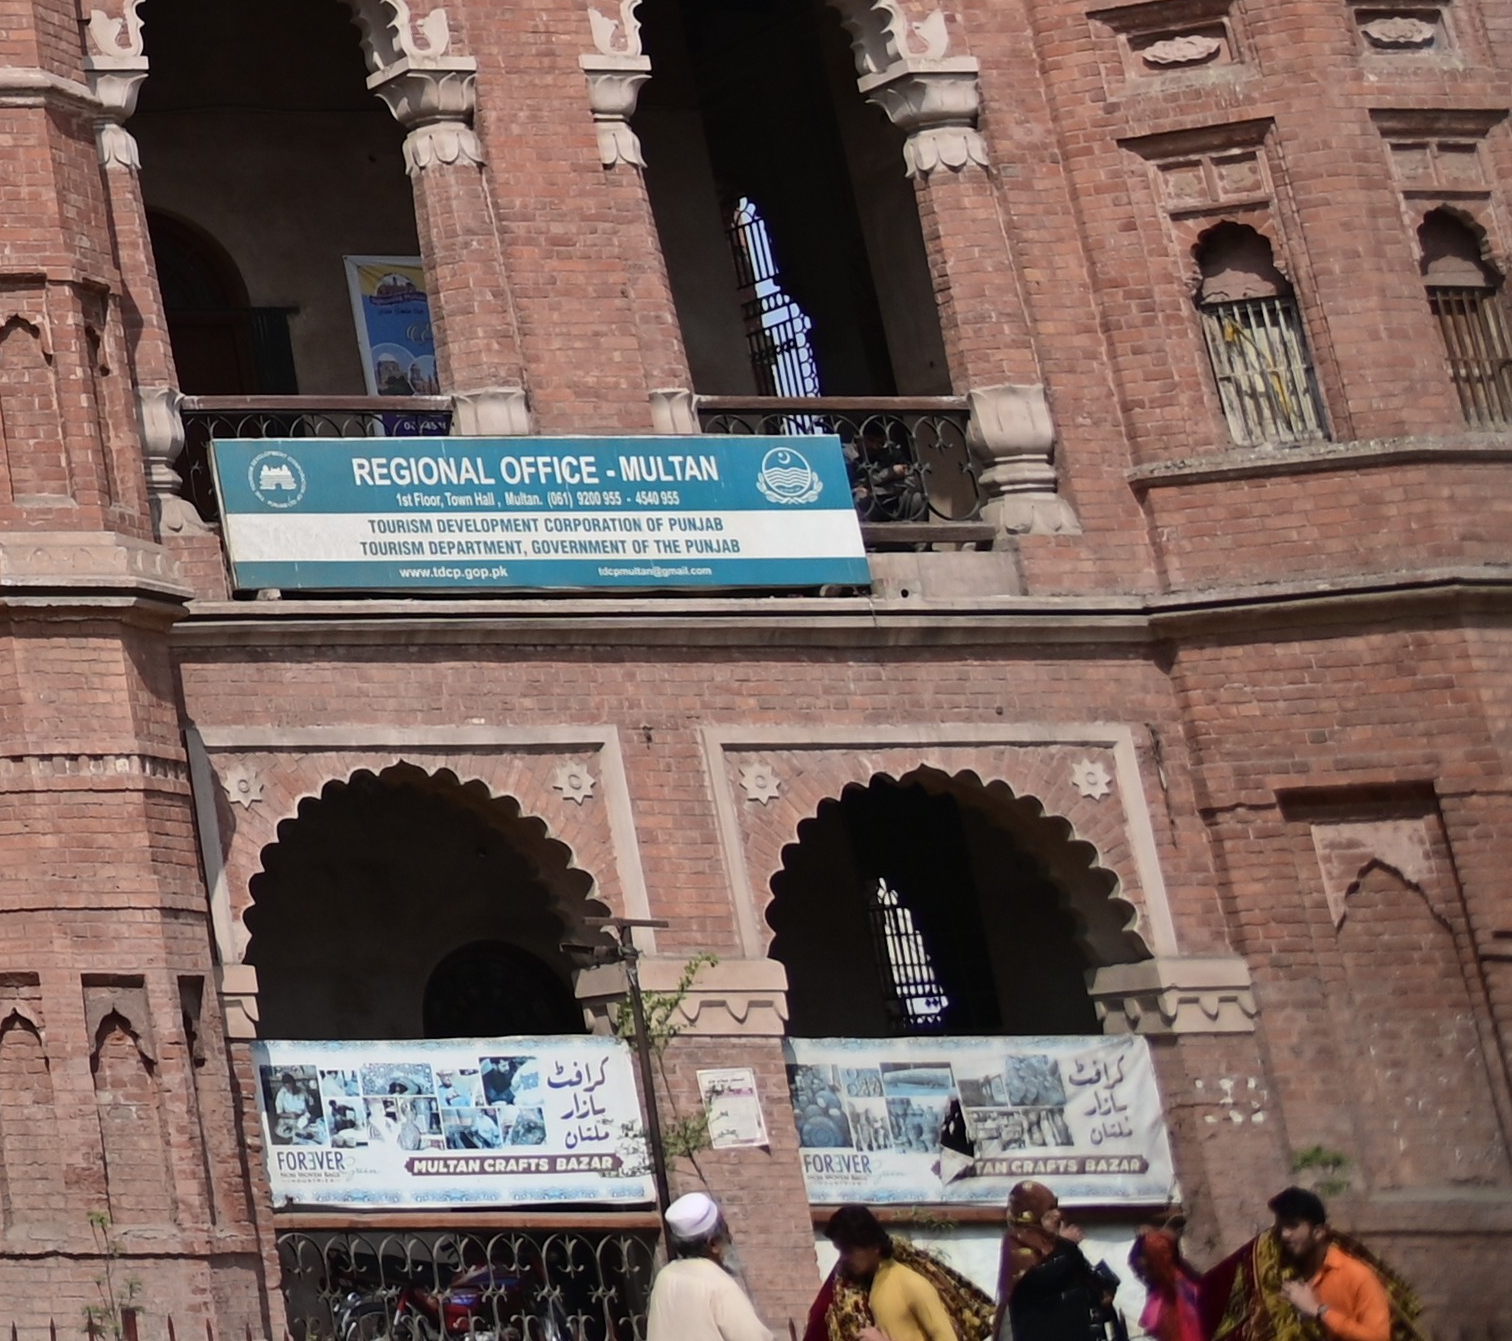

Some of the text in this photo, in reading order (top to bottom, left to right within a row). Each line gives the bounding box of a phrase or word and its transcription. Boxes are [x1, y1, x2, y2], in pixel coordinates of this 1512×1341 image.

[351, 457, 495, 485] REGIONAL
[499, 456, 599, 485] OFFICE
[620, 455, 719, 481] MULTAN
[396, 492, 413, 506] 1st
[413, 492, 444, 508] Floor,
[444, 492, 473, 506] Town
[474, 491, 495, 506] Hall
[547, 491, 573, 509] (061)
[577, 491, 601, 505] 9200
[602, 491, 622, 505] 955
[635, 491, 659, 505] 4540
[660, 491, 680, 505] 955
[368, 517, 723, 534] TOURISM DEVELOPMENT CORPORATION OF PUNJAB
[360, 539, 741, 557] TOURISM DEPARTMENT, GOVERNMENT OF THE PUNJAB
[399, 566, 712, 580] www.tdcp.gop.pk tdcpmultan@gmail.com
[547, 1056, 609, 1092] کرافٹ
[1069, 1054, 1124, 1089] کرافٹ
[565, 1124, 609, 1149] ملتان
[1090, 1122, 1133, 1145] ملتان
[277, 1151, 345, 1171] FOREVER
[414, 1156, 613, 1174] MULTAN CRAFTS BAZAR
[804, 1154, 872, 1174] FOREVER
[975, 1158, 1140, 1174] TAN CRAFTS BAZAR
